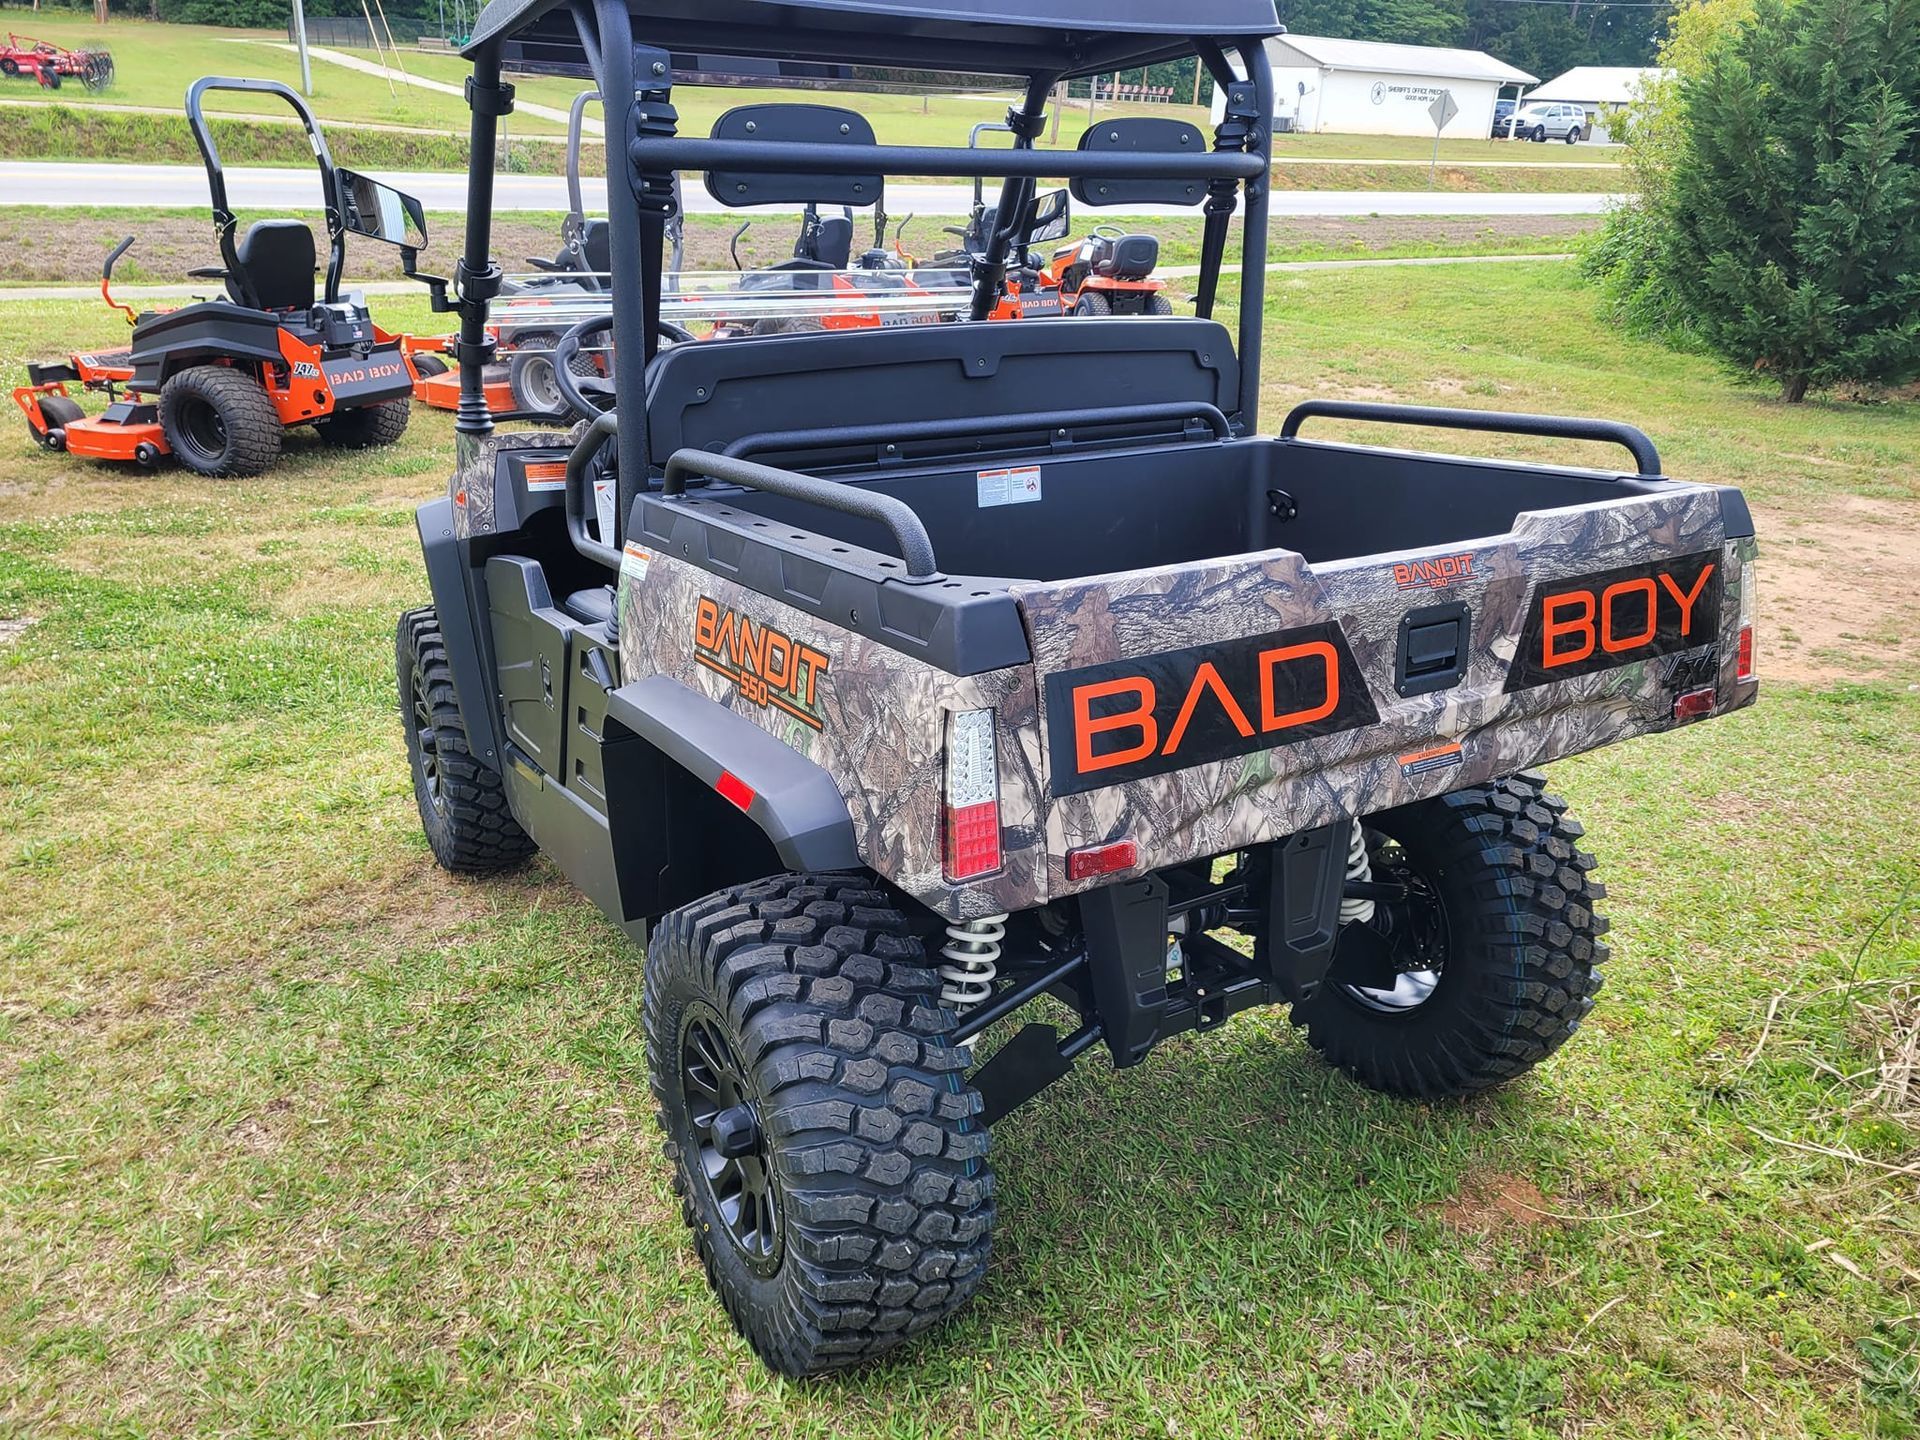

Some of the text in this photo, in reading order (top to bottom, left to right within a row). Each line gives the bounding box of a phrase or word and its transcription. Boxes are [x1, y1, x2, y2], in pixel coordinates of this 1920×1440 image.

[1411, 86, 1427, 95] OFFICE
[1022, 299, 1058, 308] BAD BOY
[330, 363, 402, 385] BAD BOY
[1393, 553, 1474, 585] BANDIT
[1430, 577, 1449, 589] 550
[695, 594, 830, 710] BANDIT
[1073, 563, 1716, 774] BAD BOY
[739, 668, 769, 710] 550
